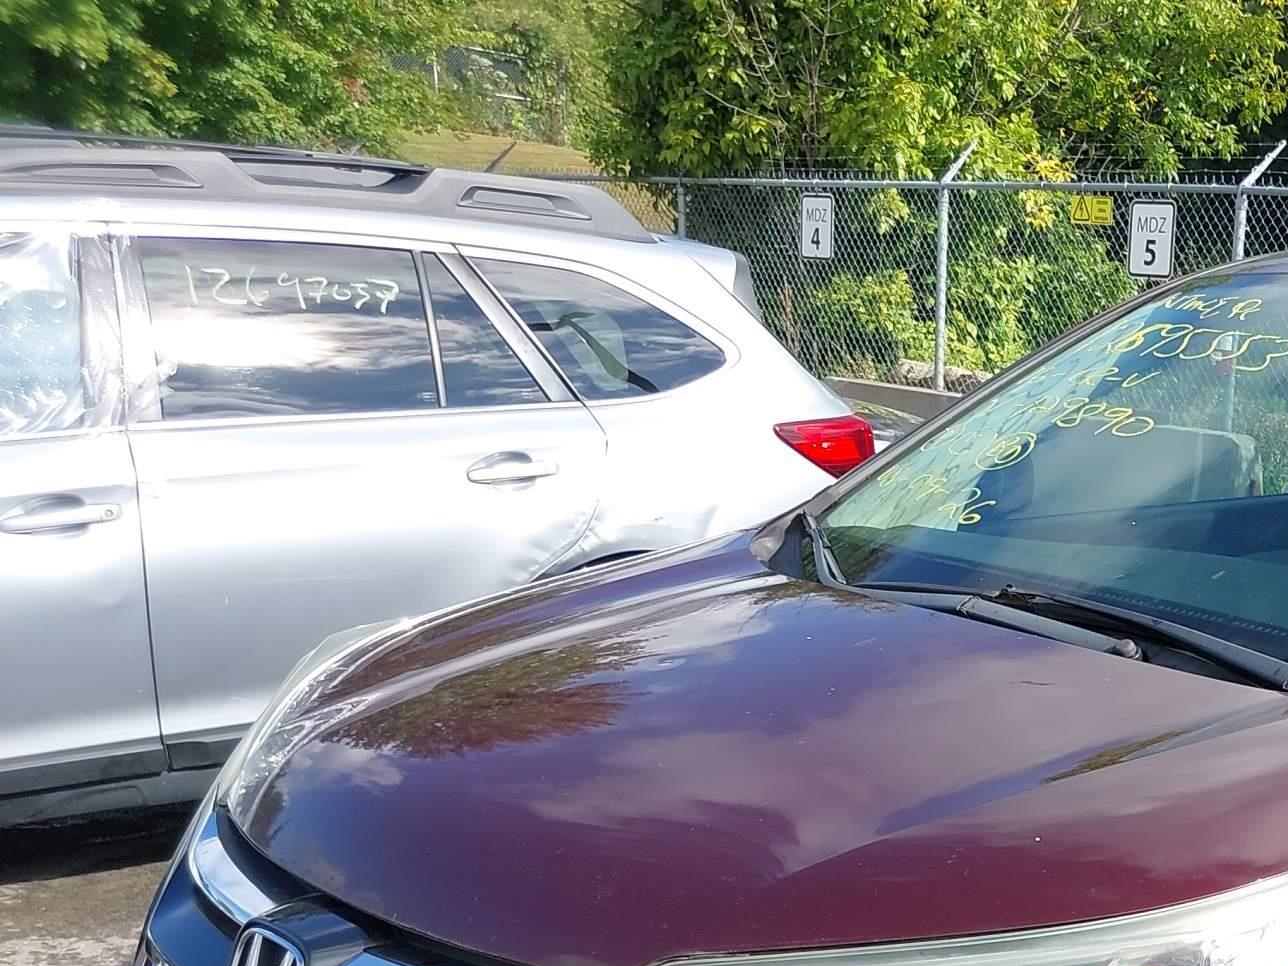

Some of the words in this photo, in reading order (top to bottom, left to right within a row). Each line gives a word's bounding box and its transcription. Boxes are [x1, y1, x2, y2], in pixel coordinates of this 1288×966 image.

[806, 208, 828, 222] MDZ
[1136, 216, 1167, 233] MDZ
[811, 227, 821, 250] 4
[1143, 239, 1157, 266] 5
